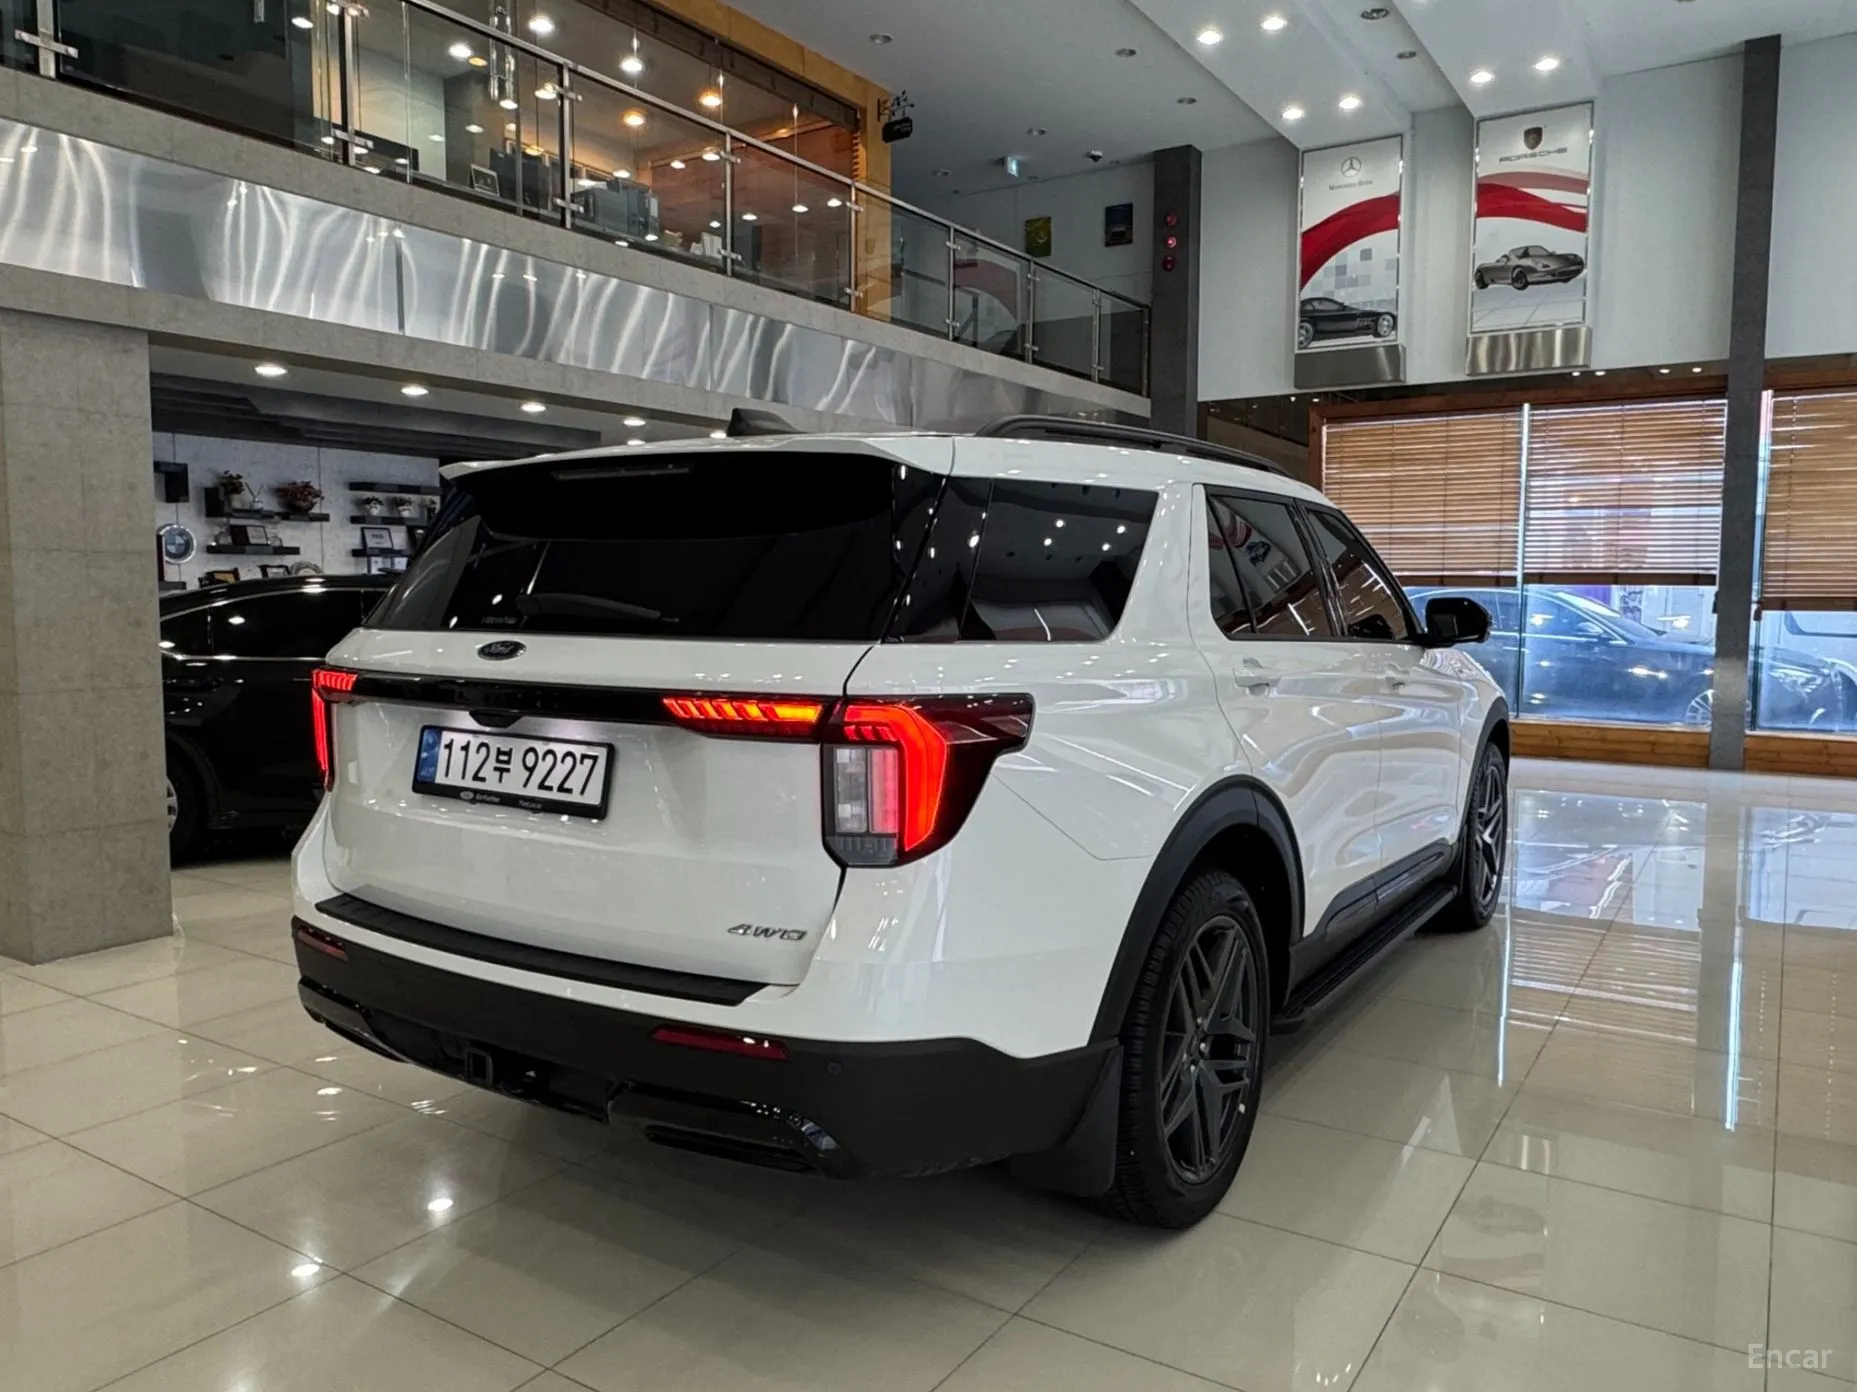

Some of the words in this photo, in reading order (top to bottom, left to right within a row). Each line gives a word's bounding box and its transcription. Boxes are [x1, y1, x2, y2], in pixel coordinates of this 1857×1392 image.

[1499, 147, 1568, 162] PORSCHE
[444, 738, 513, 784] 112부
[522, 746, 599, 796] 9227
[727, 923, 807, 941] 4WD
